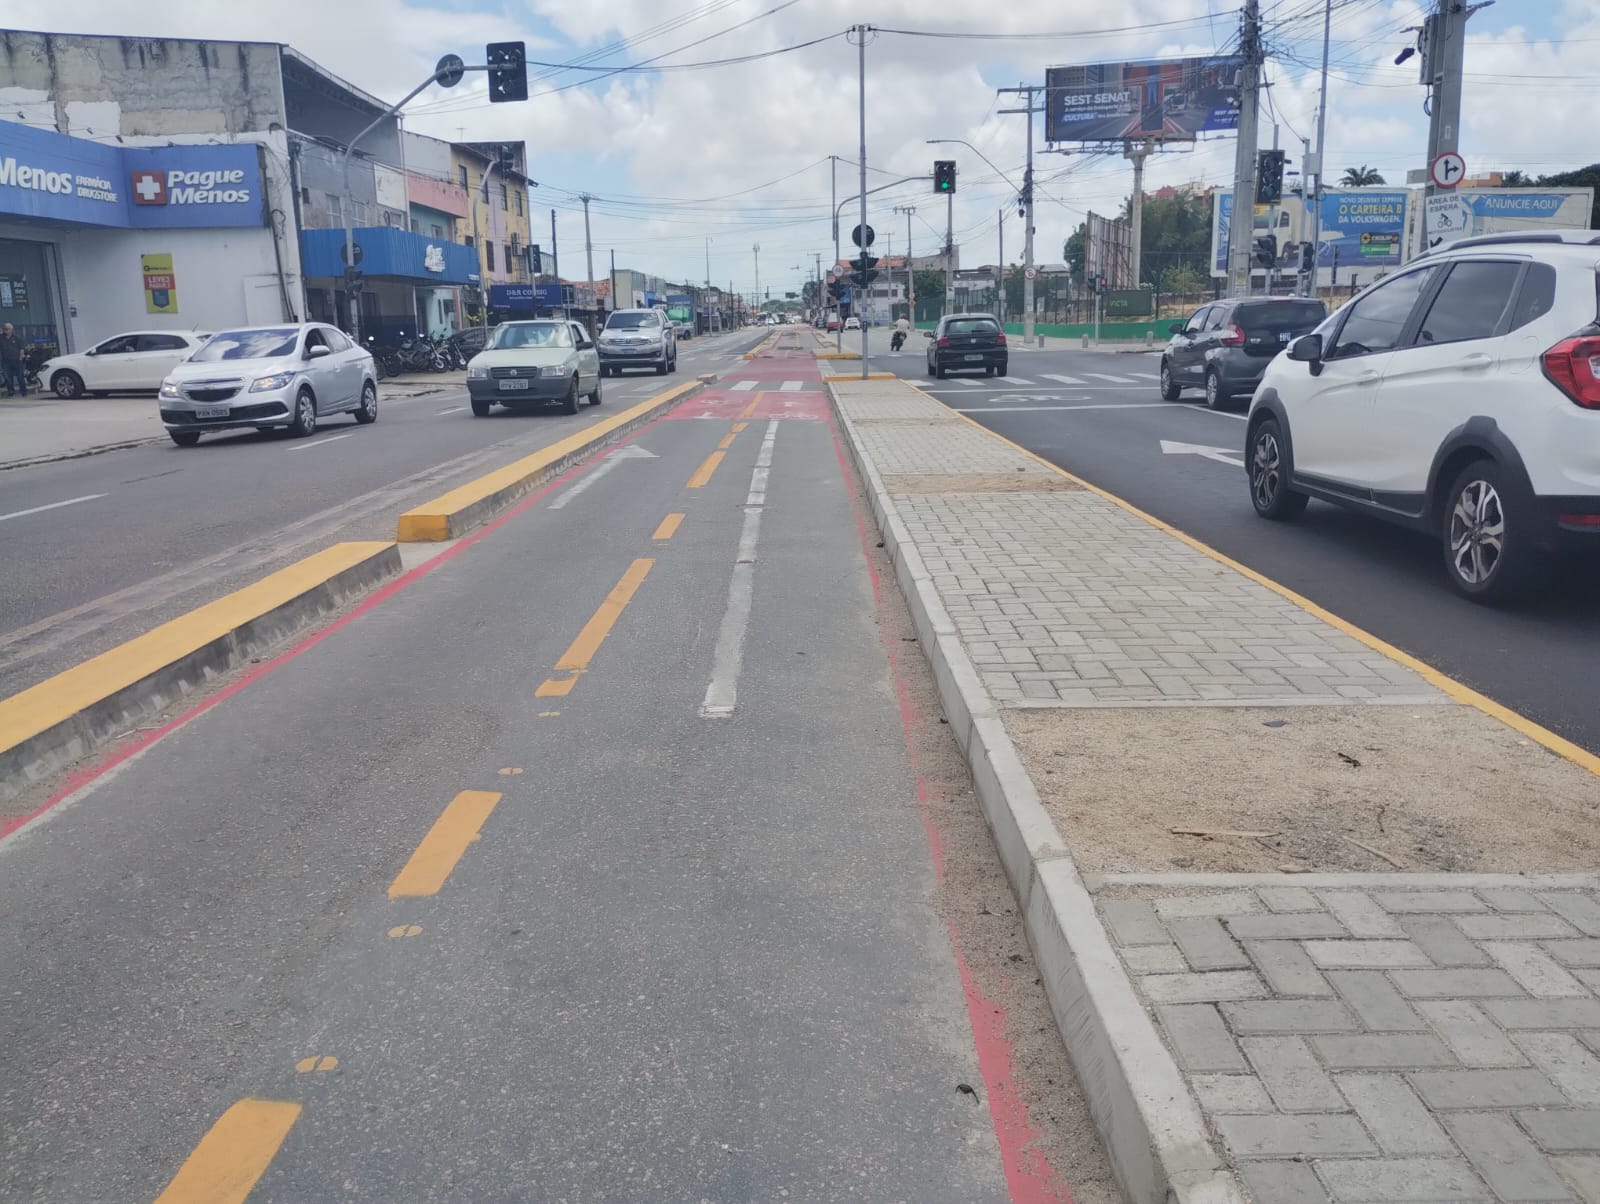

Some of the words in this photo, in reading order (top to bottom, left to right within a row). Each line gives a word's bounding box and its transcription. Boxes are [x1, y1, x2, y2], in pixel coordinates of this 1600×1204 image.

[1064, 94, 1092, 106] SEST
[1094, 92, 1129, 104] SENAT
[0, 157, 73, 194] Menos
[168, 169, 244, 190] Pague
[77, 187, 119, 202] DRUGSTORE
[170, 187, 250, 204] Menos
[1339, 204, 1347, 215] O
[1350, 204, 1393, 215] CARTEIRA
[1396, 204, 1402, 214] B
[1430, 203, 1458, 213] ESPERA
[1485, 198, 1531, 209] ANUNCIE
[1532, 198, 1558, 209] AQUI
[1338, 215, 1349, 224] DA
